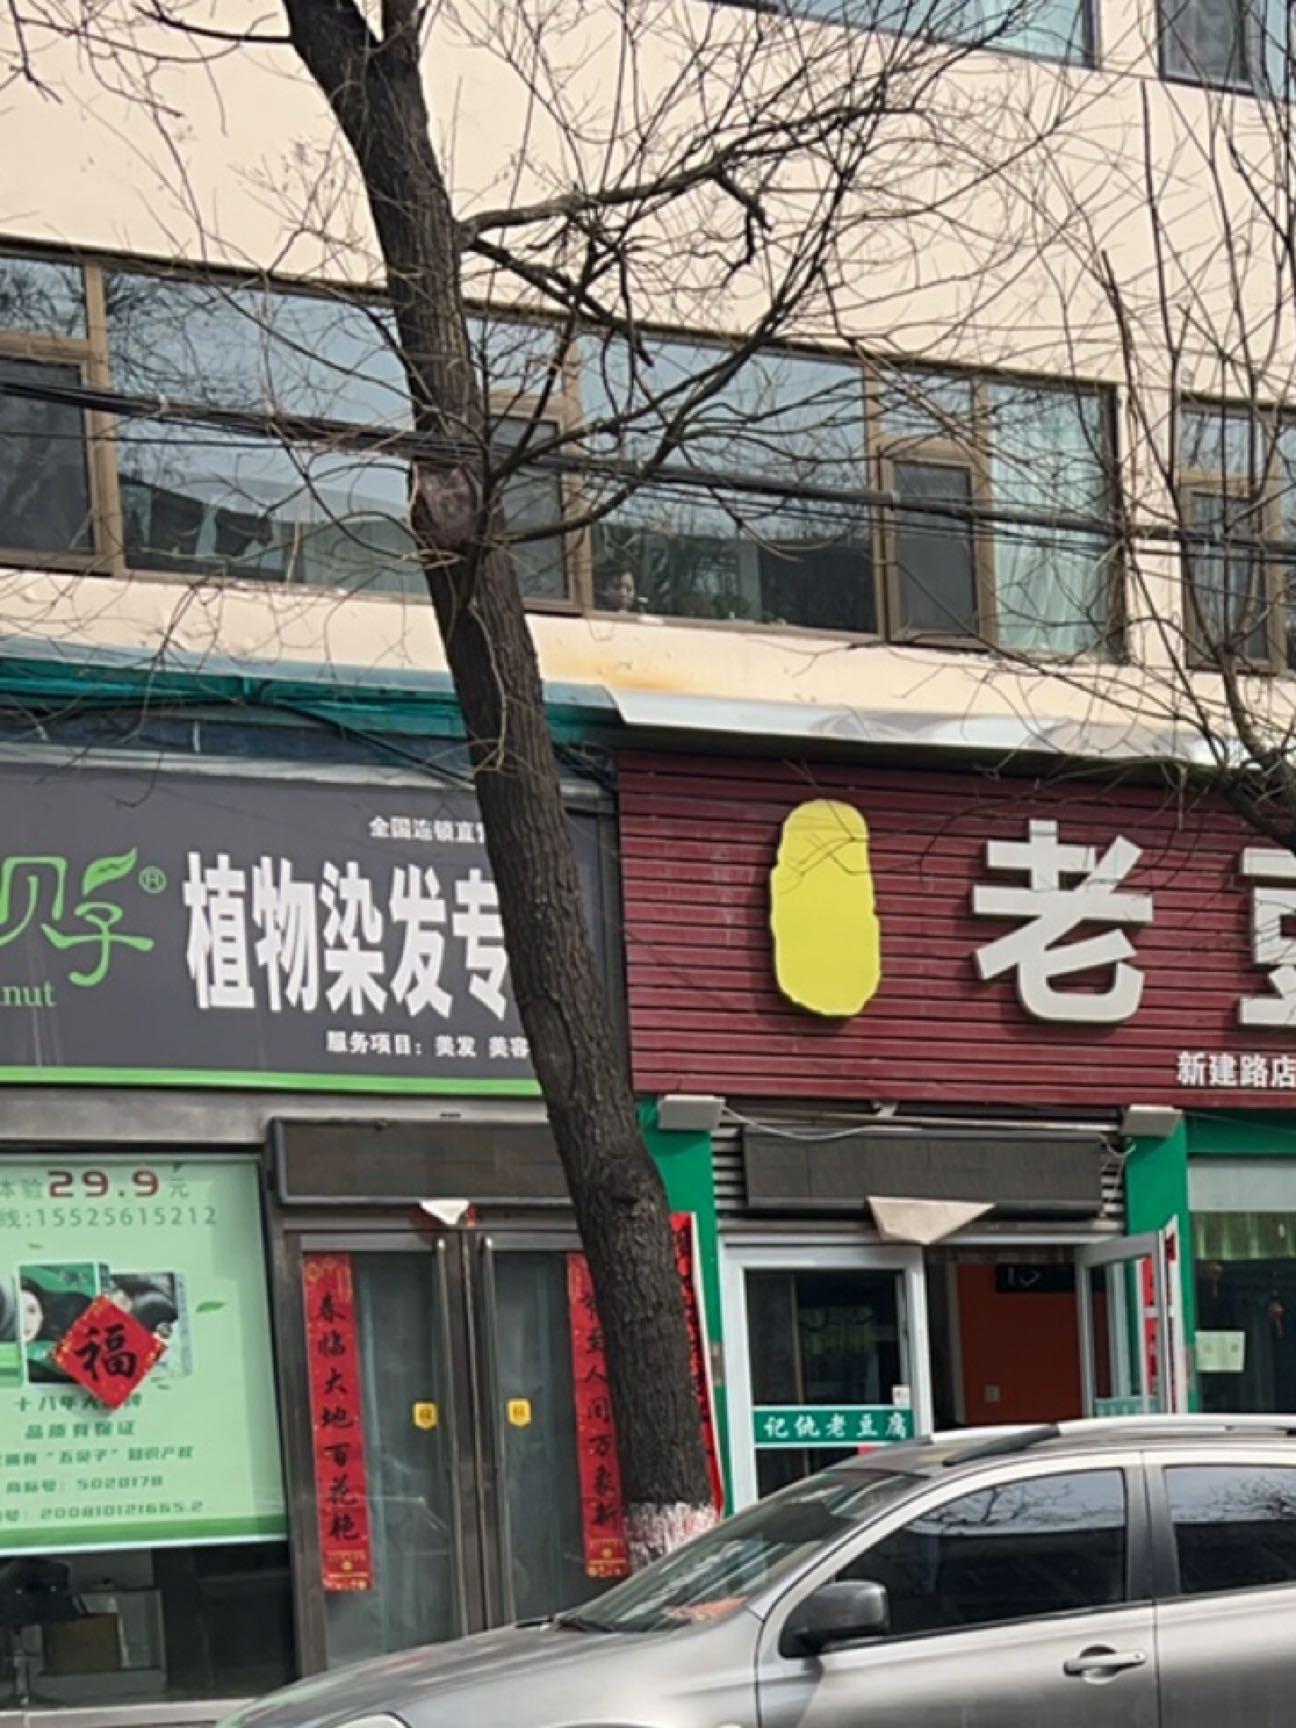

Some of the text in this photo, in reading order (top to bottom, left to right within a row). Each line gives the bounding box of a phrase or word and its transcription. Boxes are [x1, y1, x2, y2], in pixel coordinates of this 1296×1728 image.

[182, 849, 510, 1020] 植物染发专
[1177, 1050, 1296, 1088] 新建路店
[47, 1169, 160, 1199] 29.9
[74, 1323, 138, 1379] 福
